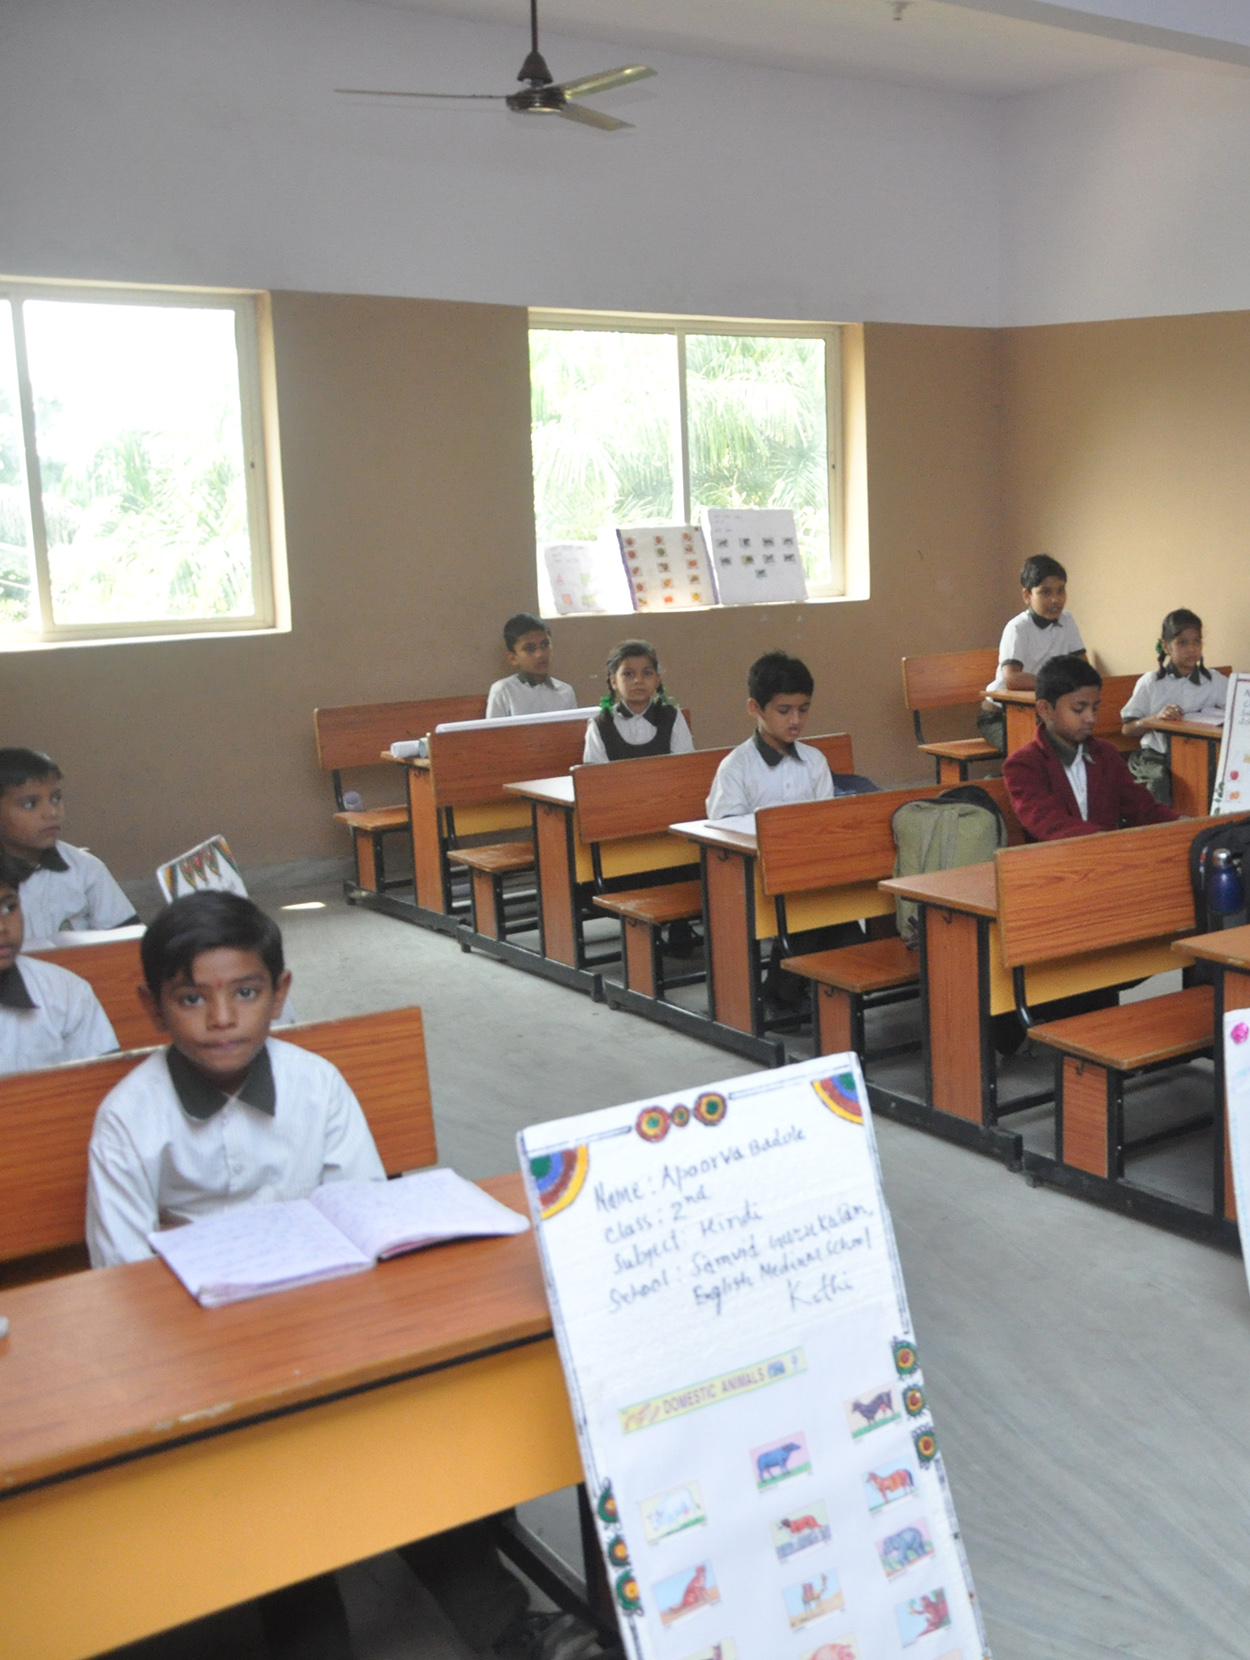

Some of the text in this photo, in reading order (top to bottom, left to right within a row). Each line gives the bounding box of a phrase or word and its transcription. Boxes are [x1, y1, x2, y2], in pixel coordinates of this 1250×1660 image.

[671, 1184, 712, 1221] 2nd
[662, 1367, 766, 1415] DOMESTIC ANIMALS
